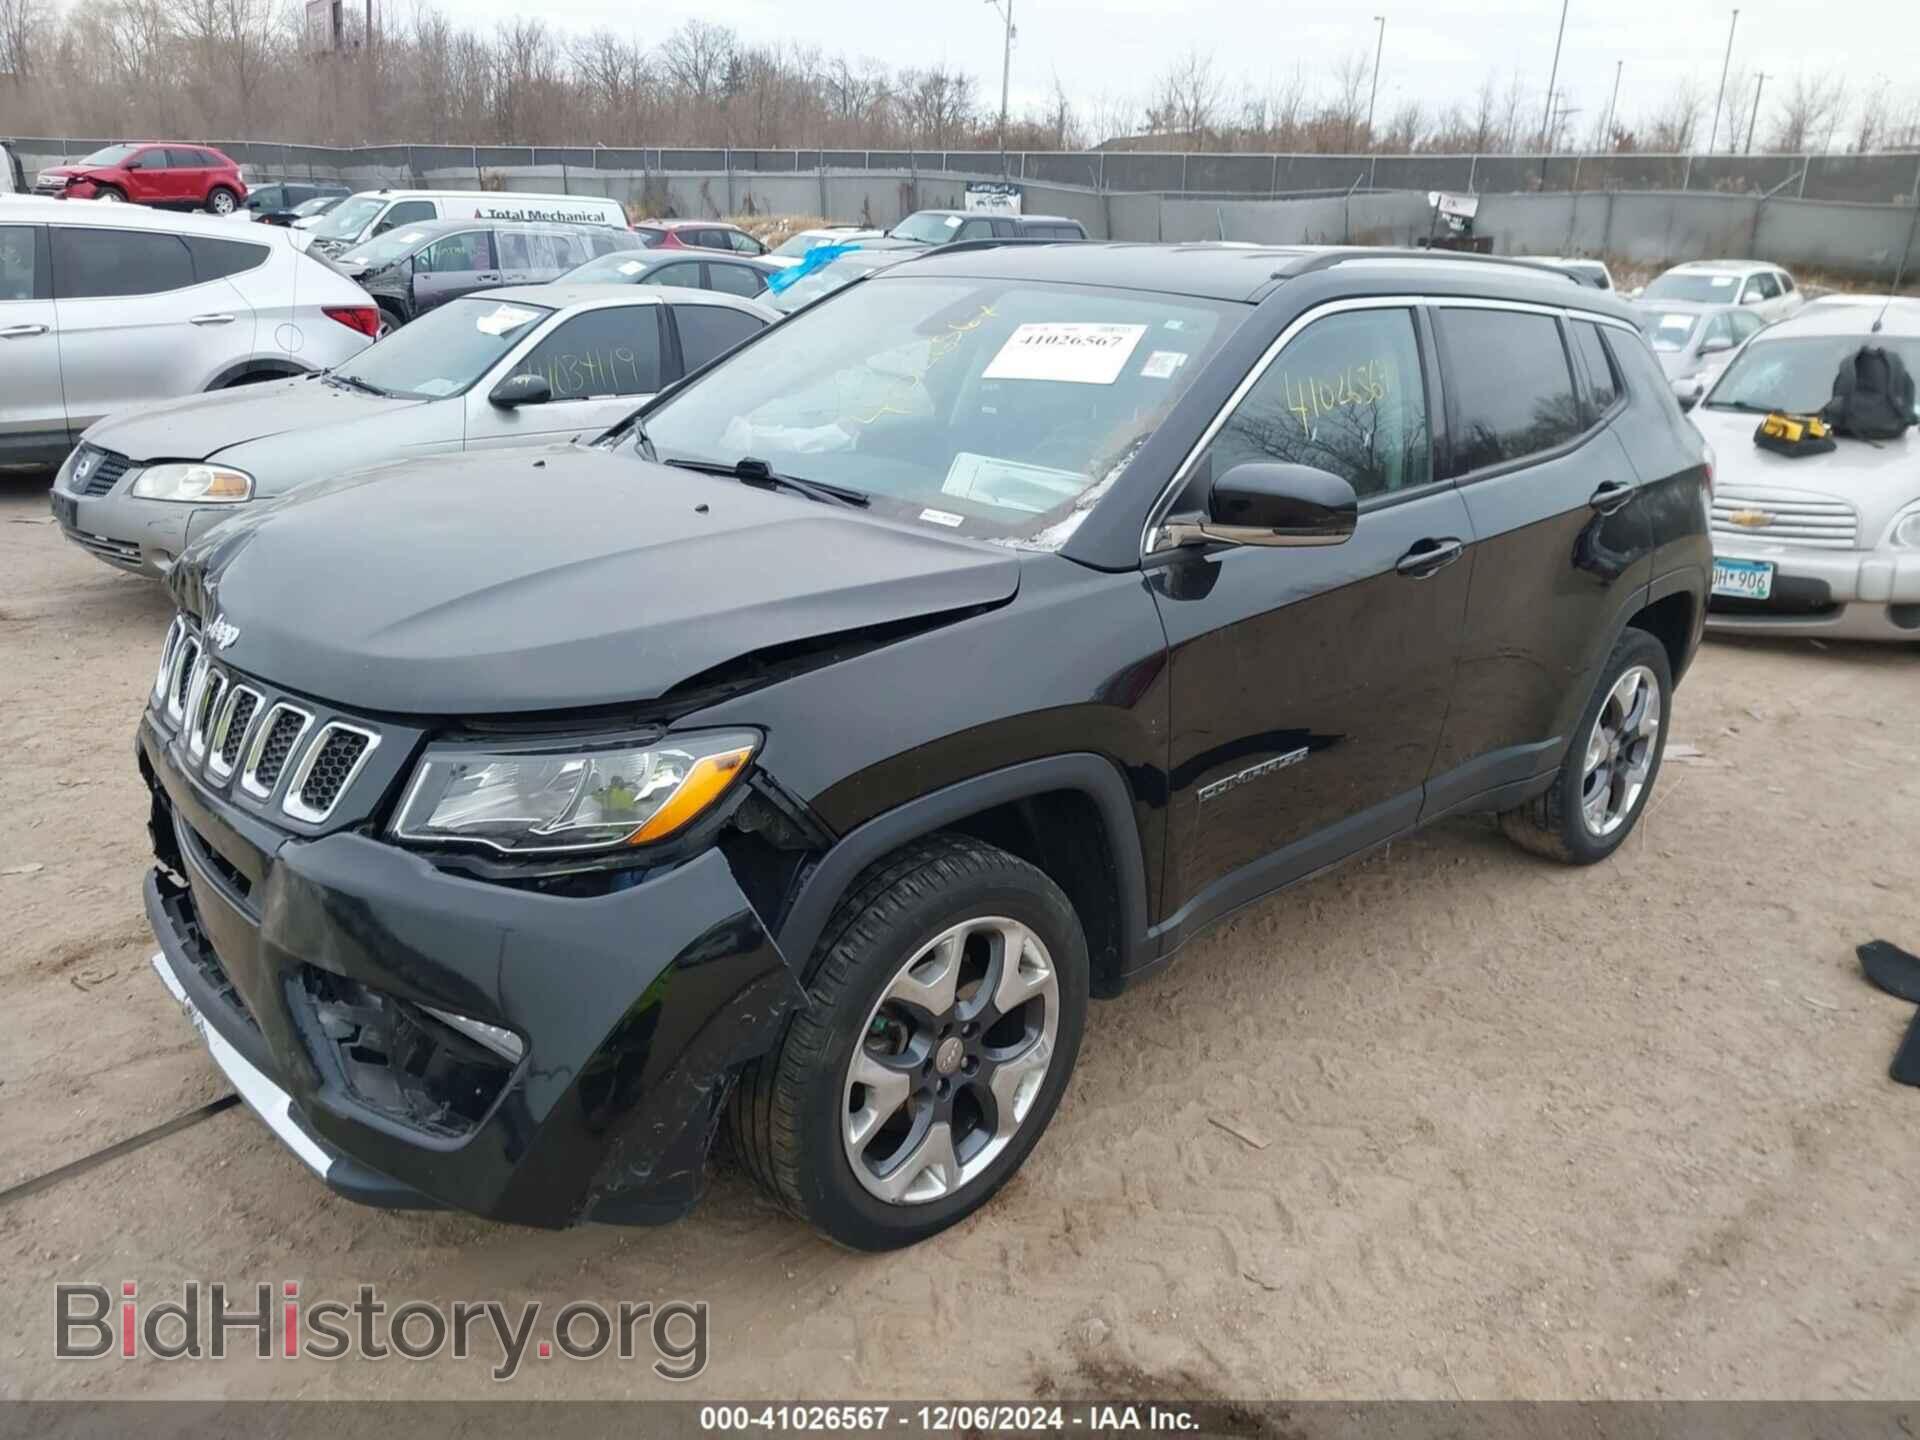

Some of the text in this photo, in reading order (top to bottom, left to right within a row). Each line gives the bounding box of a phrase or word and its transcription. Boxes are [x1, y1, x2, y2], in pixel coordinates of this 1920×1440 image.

[488, 209, 606, 222] Total Mechanical
[1020, 334, 1124, 347] 41026567
